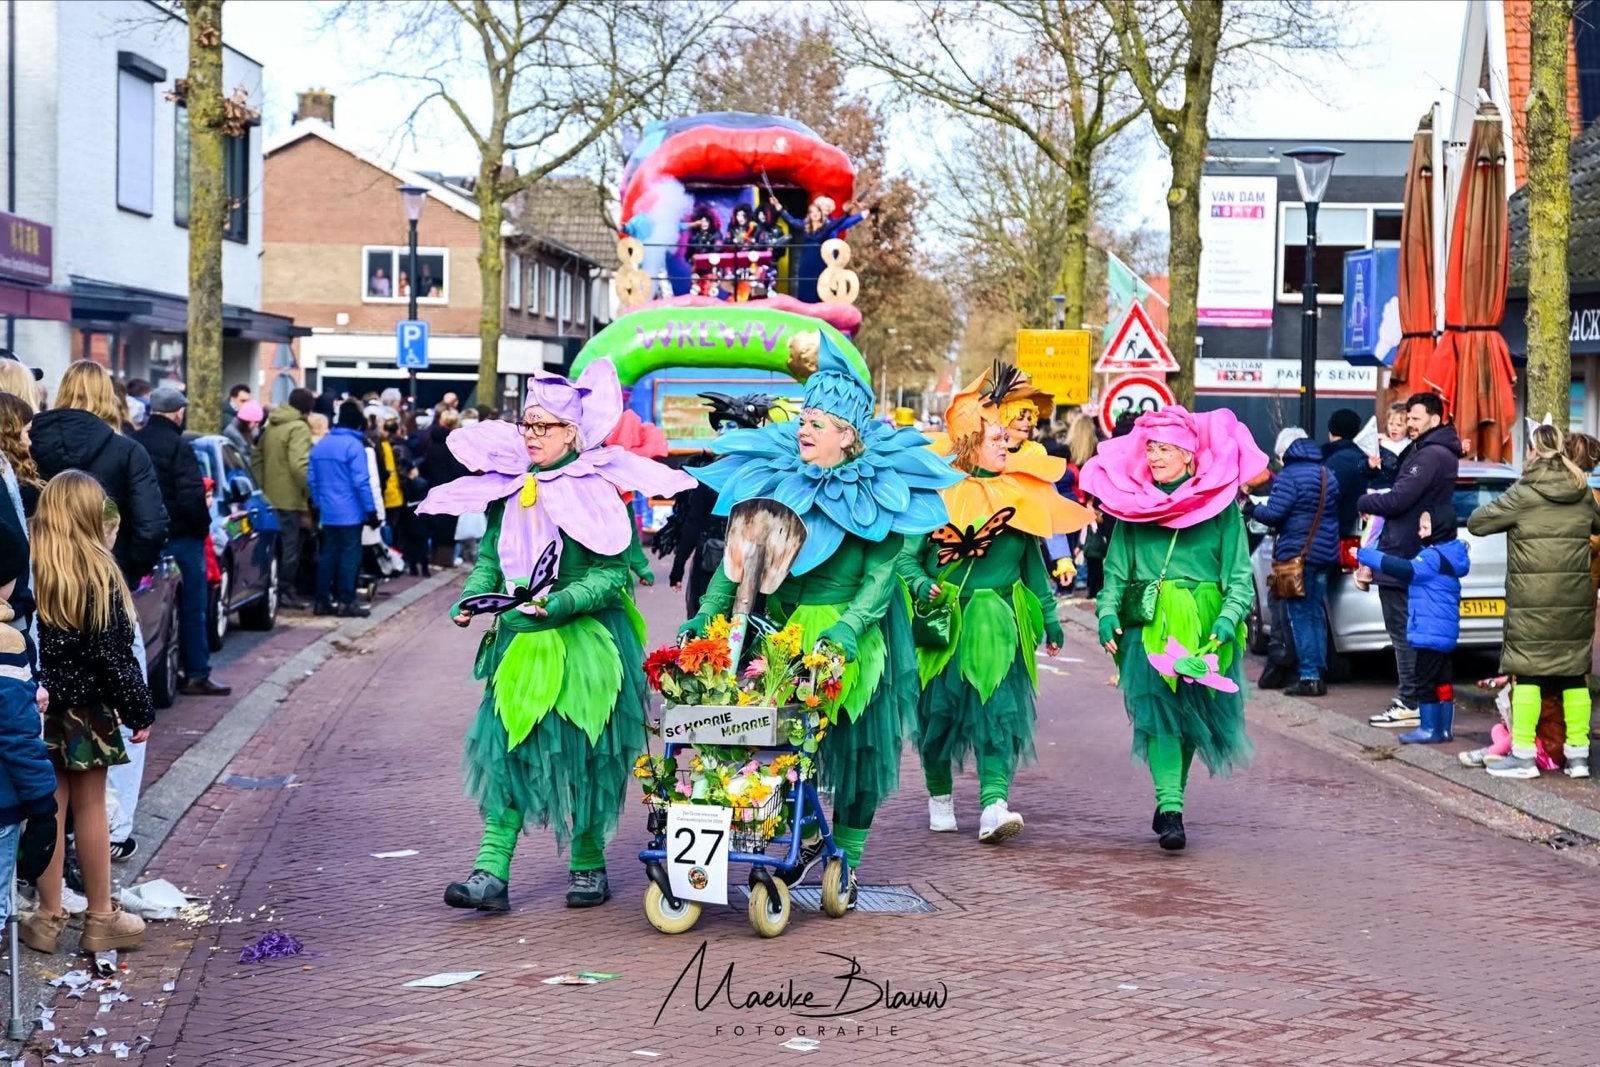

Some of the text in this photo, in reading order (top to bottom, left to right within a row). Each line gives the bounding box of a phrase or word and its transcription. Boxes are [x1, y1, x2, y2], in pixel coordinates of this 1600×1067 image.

[1211, 191, 1266, 202] VAN DAM
[404, 325, 421, 348] P
[636, 320, 786, 352] WKEWV
[1219, 361, 1263, 370] VAN DAM
[1277, 368, 1320, 380] PARY
[665, 712, 732, 738] SCHORRIE
[720, 716, 771, 737] MORRIE
[674, 827, 725, 866] 27
